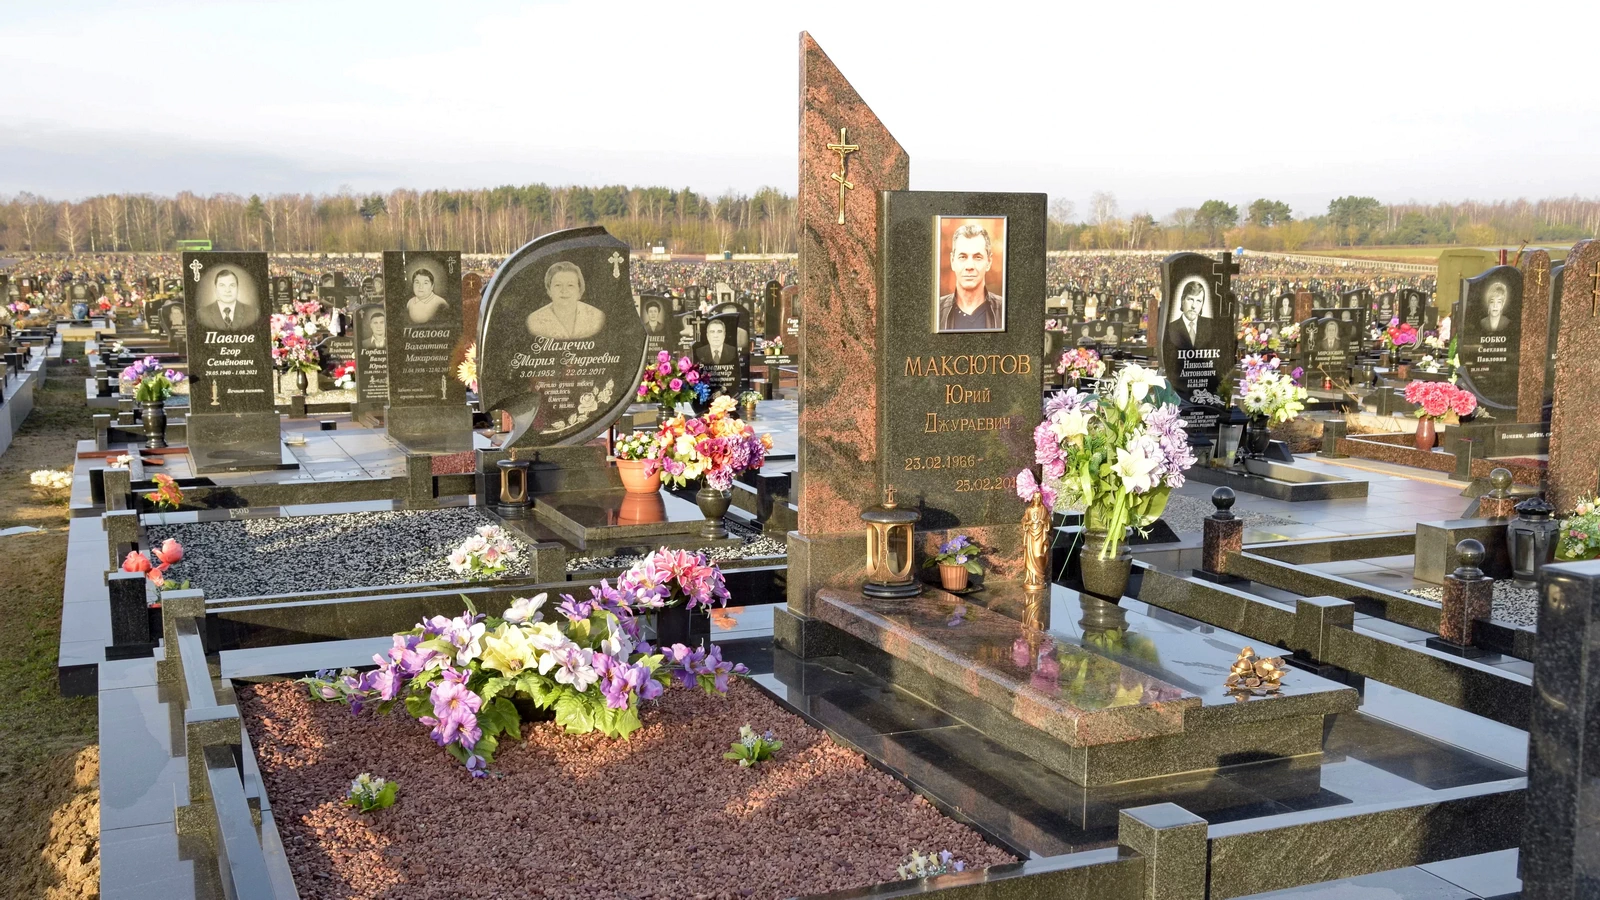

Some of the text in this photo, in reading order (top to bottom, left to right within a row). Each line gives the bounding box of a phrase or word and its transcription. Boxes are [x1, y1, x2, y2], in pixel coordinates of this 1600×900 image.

[204, 331, 255, 344] Павлов
[403, 327, 450, 339] Павлова
[404, 342, 449, 351] Валентина
[531, 335, 595, 354] Малечко
[220, 347, 241, 357] Егор
[1177, 349, 1220, 360] ЦОНИК
[207, 358, 254, 367] Семёнович
[405, 354, 449, 363] Макаровна
[511, 350, 620, 369] Мария Андреевна
[904, 354, 1031, 376] МАКСЮТОВ
[1183, 360, 1214, 369] Николай
[519, 367, 606, 378] 3.01.1952 22.02.2017
[1179, 369, 1216, 378] Антонович
[955, 476, 1017, 492] 25.02.201
